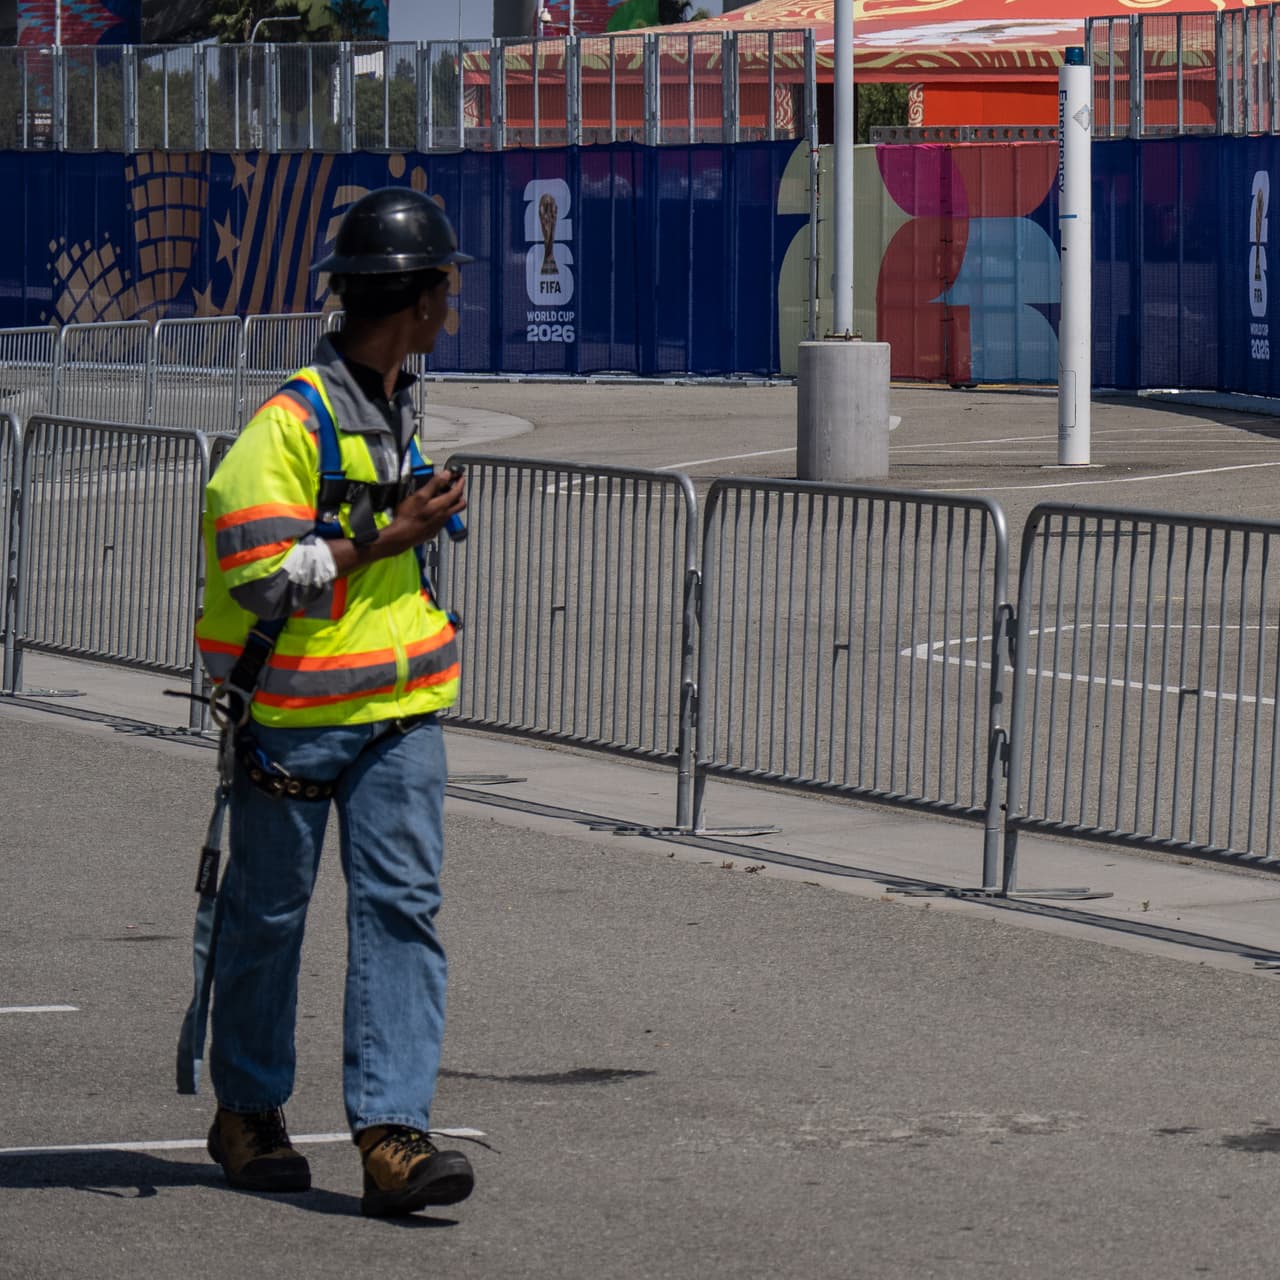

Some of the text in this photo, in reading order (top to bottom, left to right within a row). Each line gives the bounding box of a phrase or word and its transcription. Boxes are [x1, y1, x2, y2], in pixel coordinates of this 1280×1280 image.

[540, 281, 561, 294] FIFA
[526, 311, 575, 322] WORLD CUP
[526, 324, 575, 343] 2026
